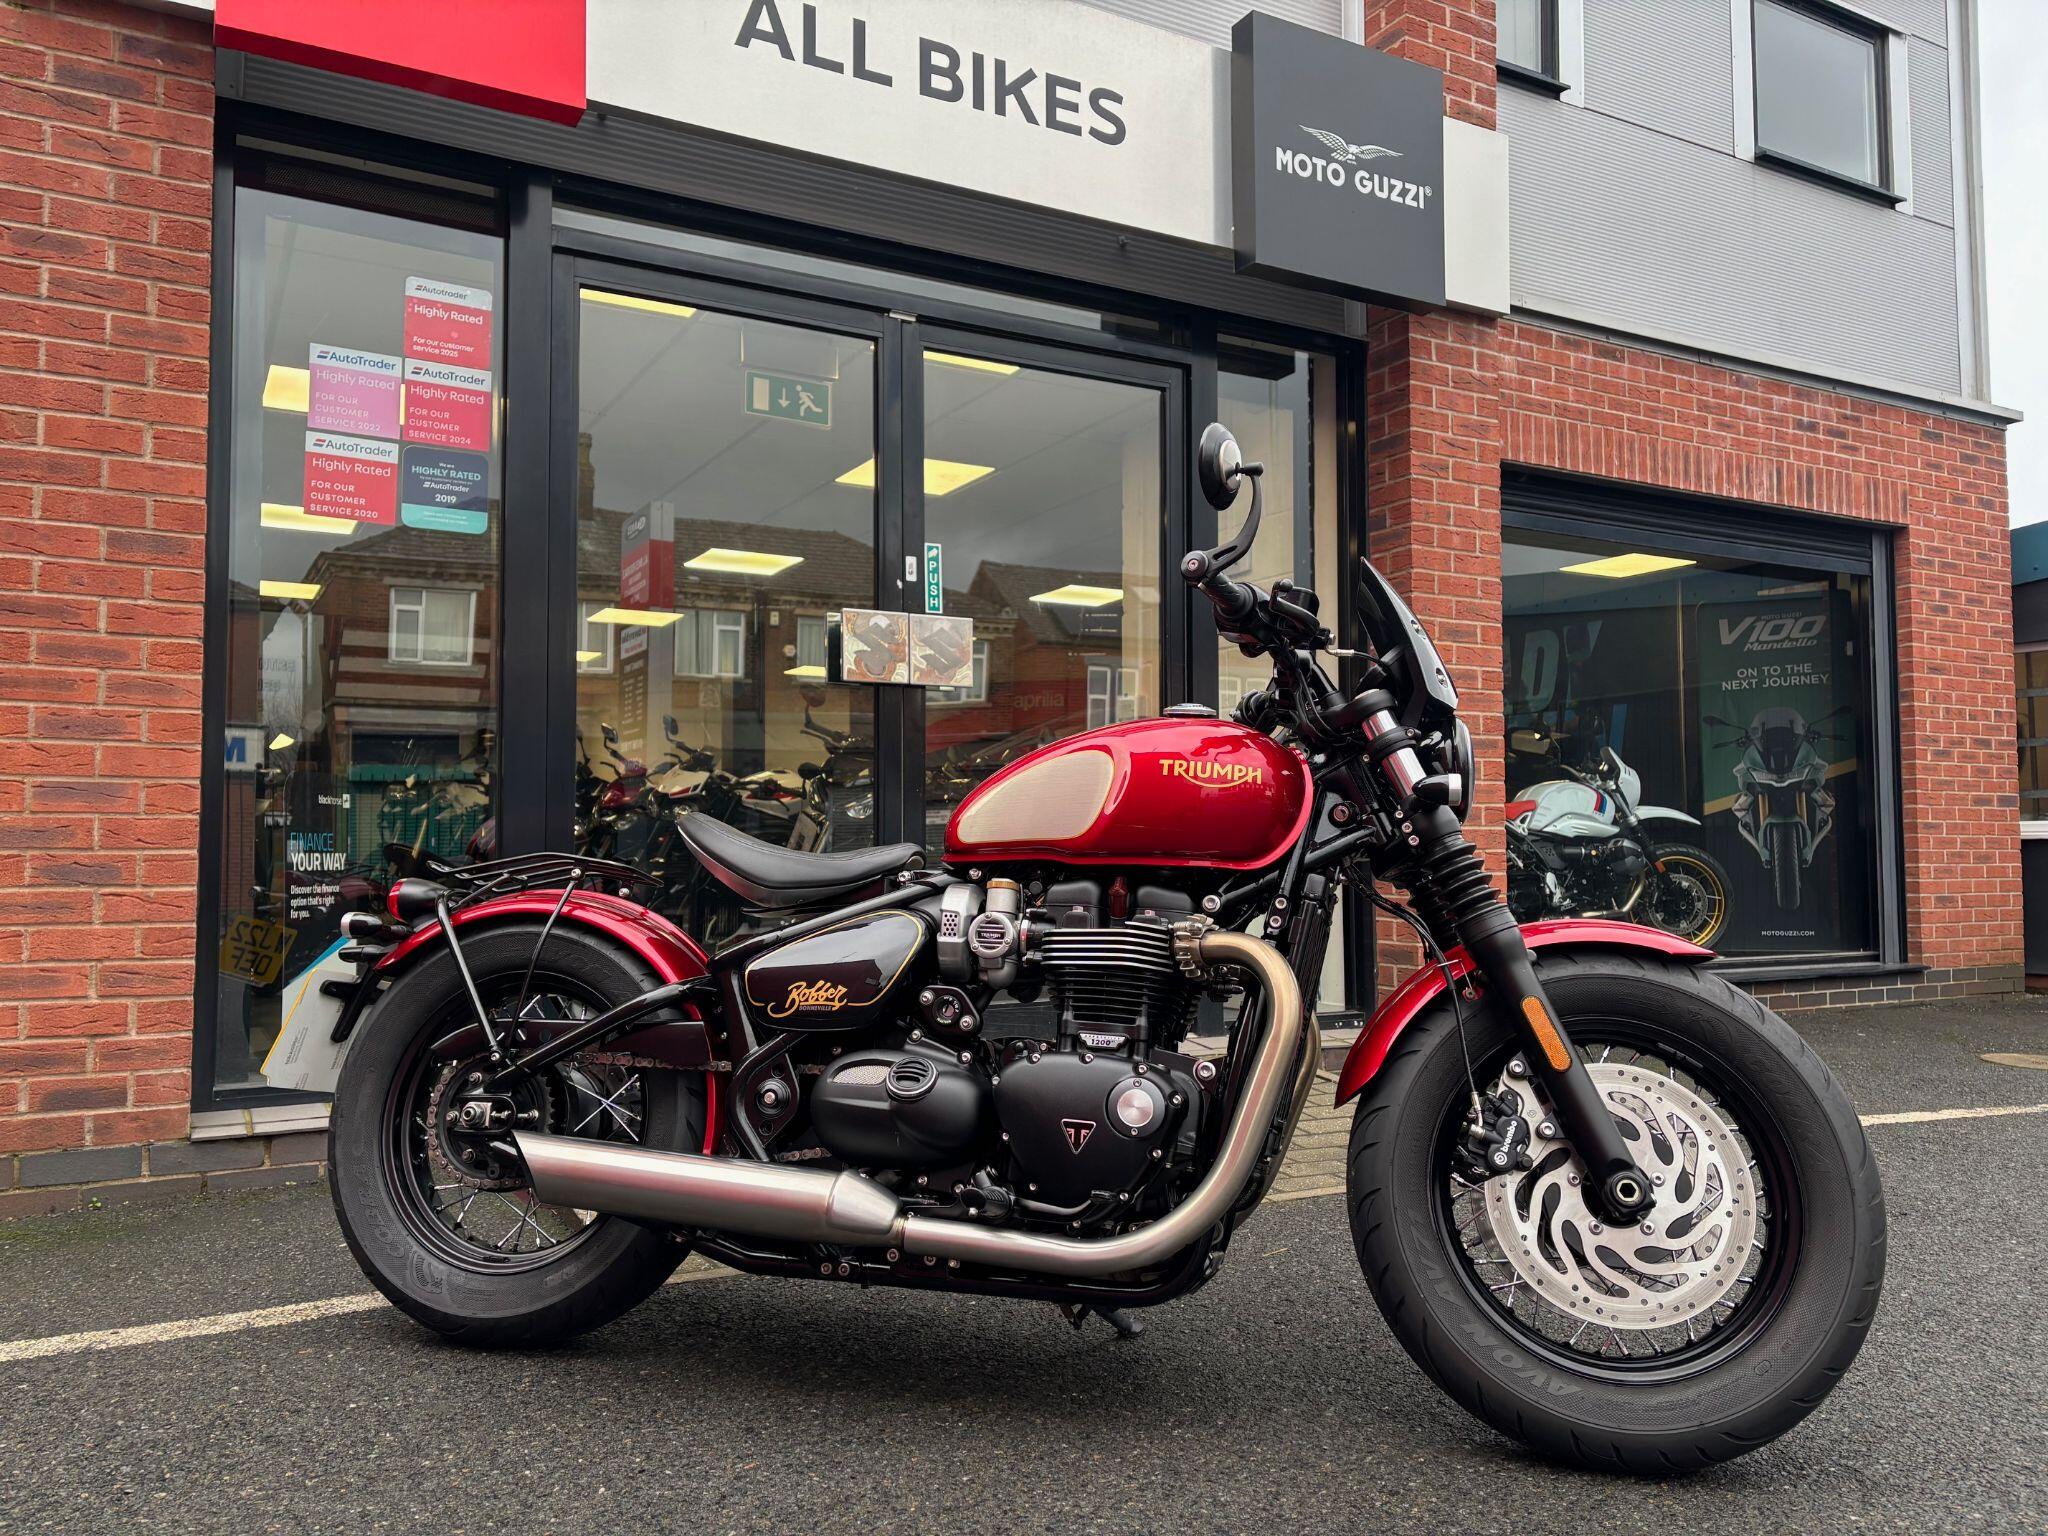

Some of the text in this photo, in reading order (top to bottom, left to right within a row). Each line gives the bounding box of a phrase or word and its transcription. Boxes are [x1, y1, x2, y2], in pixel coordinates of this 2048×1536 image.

[734, 0, 1127, 146] ALL BIKES
[1275, 146, 1346, 187] MOTO
[422, 285, 468, 300] Autotrader
[414, 304, 484, 325] Highly Rated
[412, 345, 459, 358] service 2025
[413, 336, 474, 353] For our customer
[329, 351, 397, 371] AutoTrader
[316, 368, 395, 391] Highly Rated
[422, 368, 486, 386] AutoTrader
[315, 391, 359, 405] FOR OUR
[410, 385, 485, 405] Highly Rated
[315, 403, 369, 418] CUSTOMER
[409, 406, 450, 420] FOR OUR
[314, 415, 381, 432] SERVICE 2022
[409, 418, 460, 432] CUSTOMER
[408, 429, 472, 446] SERVICE 2024
[325, 440, 393, 458] AutoTrader
[312, 457, 391, 477] Highly Rated
[411, 465, 449, 477] HIGHLY
[450, 470, 481, 481] RATED
[311, 480, 355, 493] FOR OUR
[430, 483, 469, 493] AutoTrader
[310, 491, 366, 506] CUSTOMER
[434, 493, 457, 504] 2019
[310, 503, 378, 519] SERVICE 2020
[929, 560, 938, 608] PUSH
[1718, 615, 1827, 646] V100
[1743, 637, 1818, 652] Mandello
[1736, 663, 1813, 678] ON TO THE
[1721, 673, 1830, 691] NEXT JOURNEY
[1014, 690, 1065, 711] aprilia
[1159, 759, 1262, 788] TRIUMPH
[290, 831, 335, 852] FINANCE
[290, 852, 347, 872] YOUR WAY
[290, 883, 340, 895] Discover the finance
[290, 896, 335, 909] option that's right
[290, 908, 299, 919] for
[767, 980, 848, 1018] Bobber
[1500, 1120, 1518, 1153] brembo
[1461, 1323, 1586, 1397] AVON
